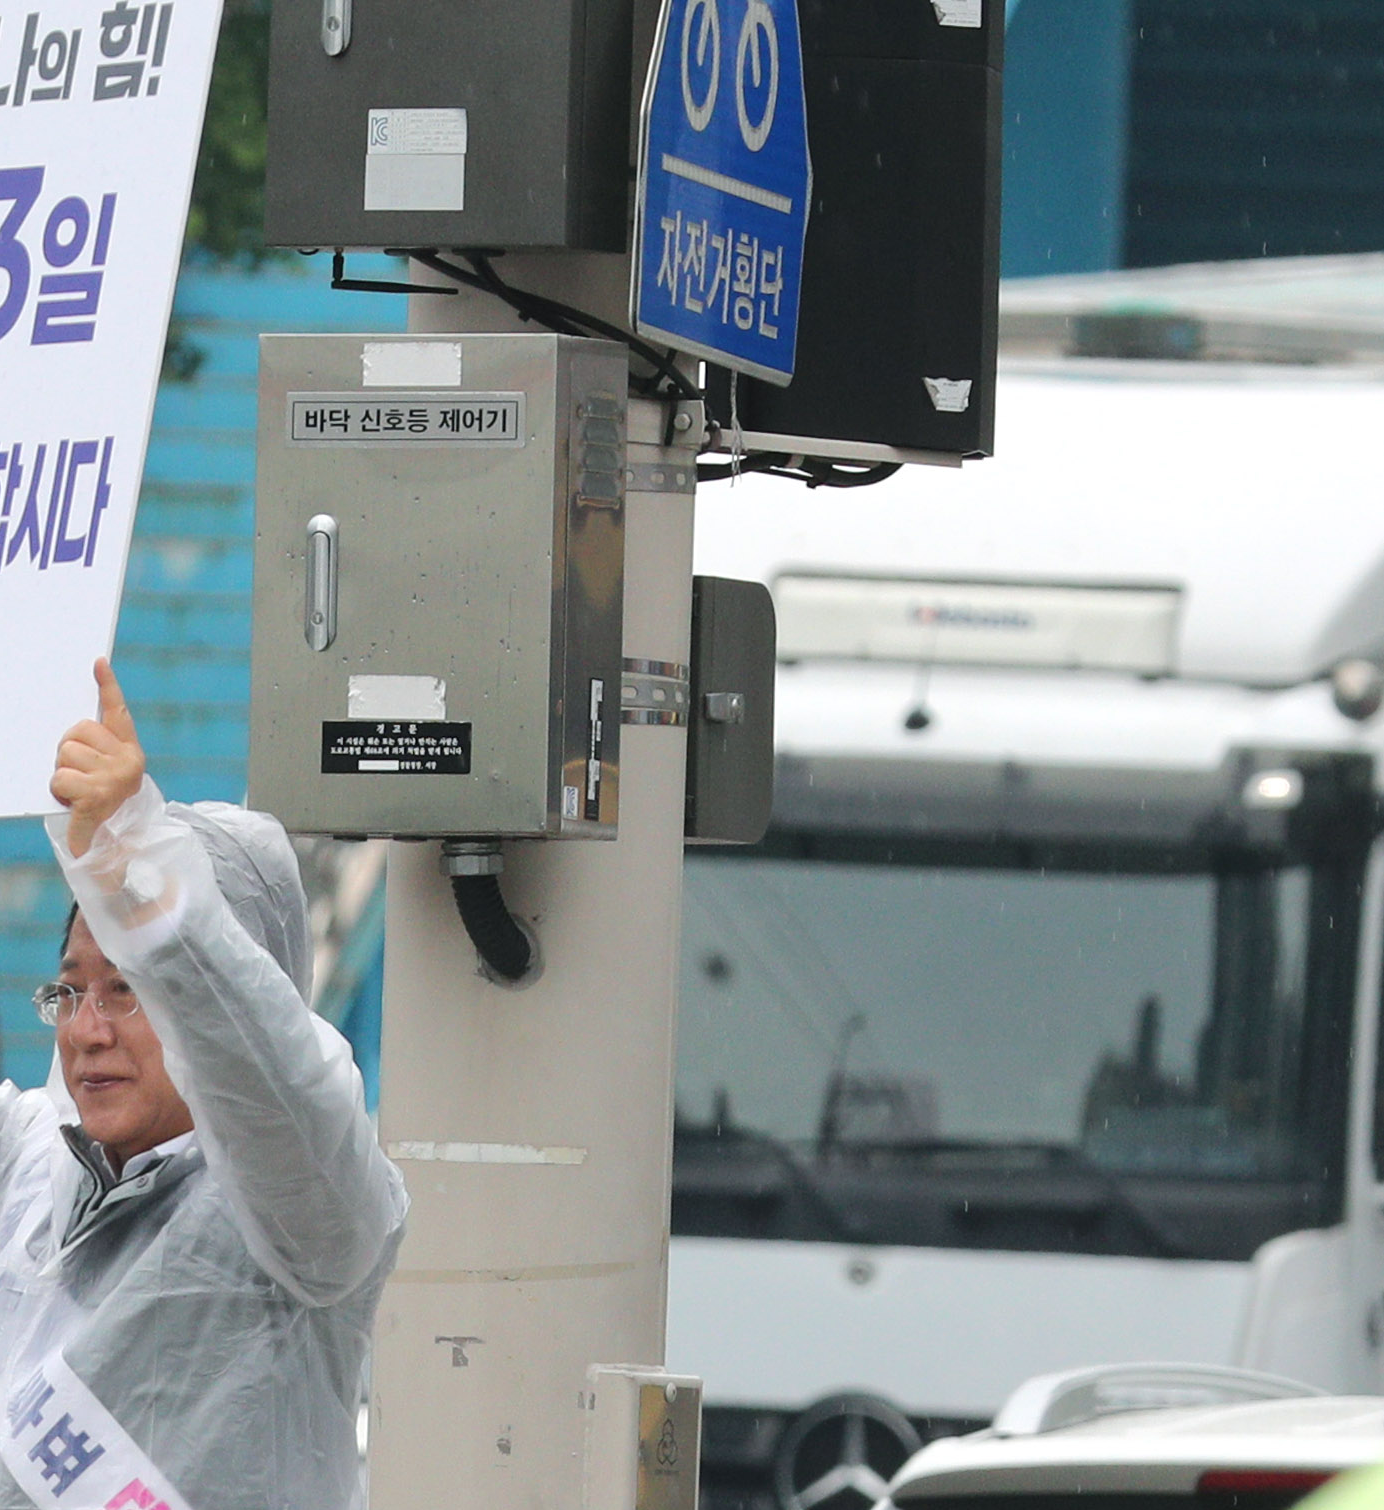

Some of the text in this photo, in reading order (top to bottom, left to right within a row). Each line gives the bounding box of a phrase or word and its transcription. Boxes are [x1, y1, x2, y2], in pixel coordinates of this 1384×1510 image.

[93, 1, 175, 102] 힘!
[656, 209, 784, 340] 자전거횡단
[304, 409, 507, 432] 바닥 신호등 제어기
